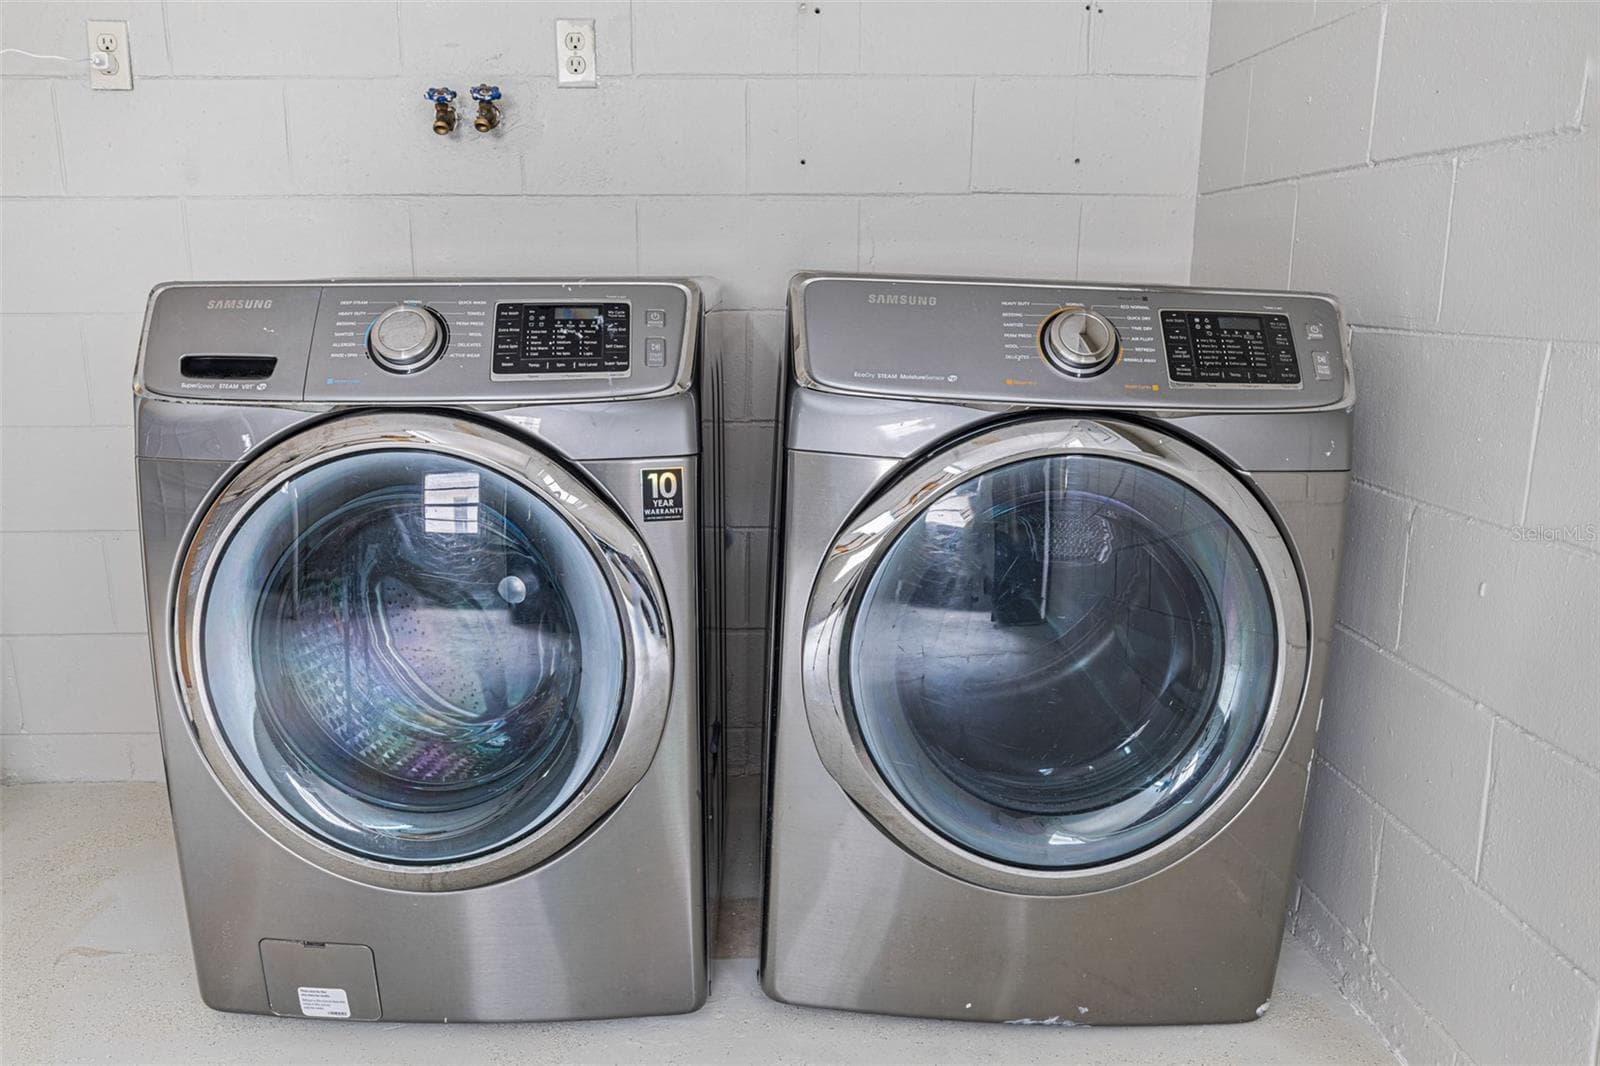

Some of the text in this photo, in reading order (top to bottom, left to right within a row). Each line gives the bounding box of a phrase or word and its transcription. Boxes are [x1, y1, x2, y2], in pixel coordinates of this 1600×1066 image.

[207, 299, 273, 310] SAMSUNG
[868, 294, 937, 306] SAMSUNG
[877, 372, 898, 380] STEAM
[900, 373, 945, 381] MoistureSensor
[647, 471, 678, 499] 10
[652, 499, 674, 508] YEAR
[644, 507, 683, 515] WARRANTY
